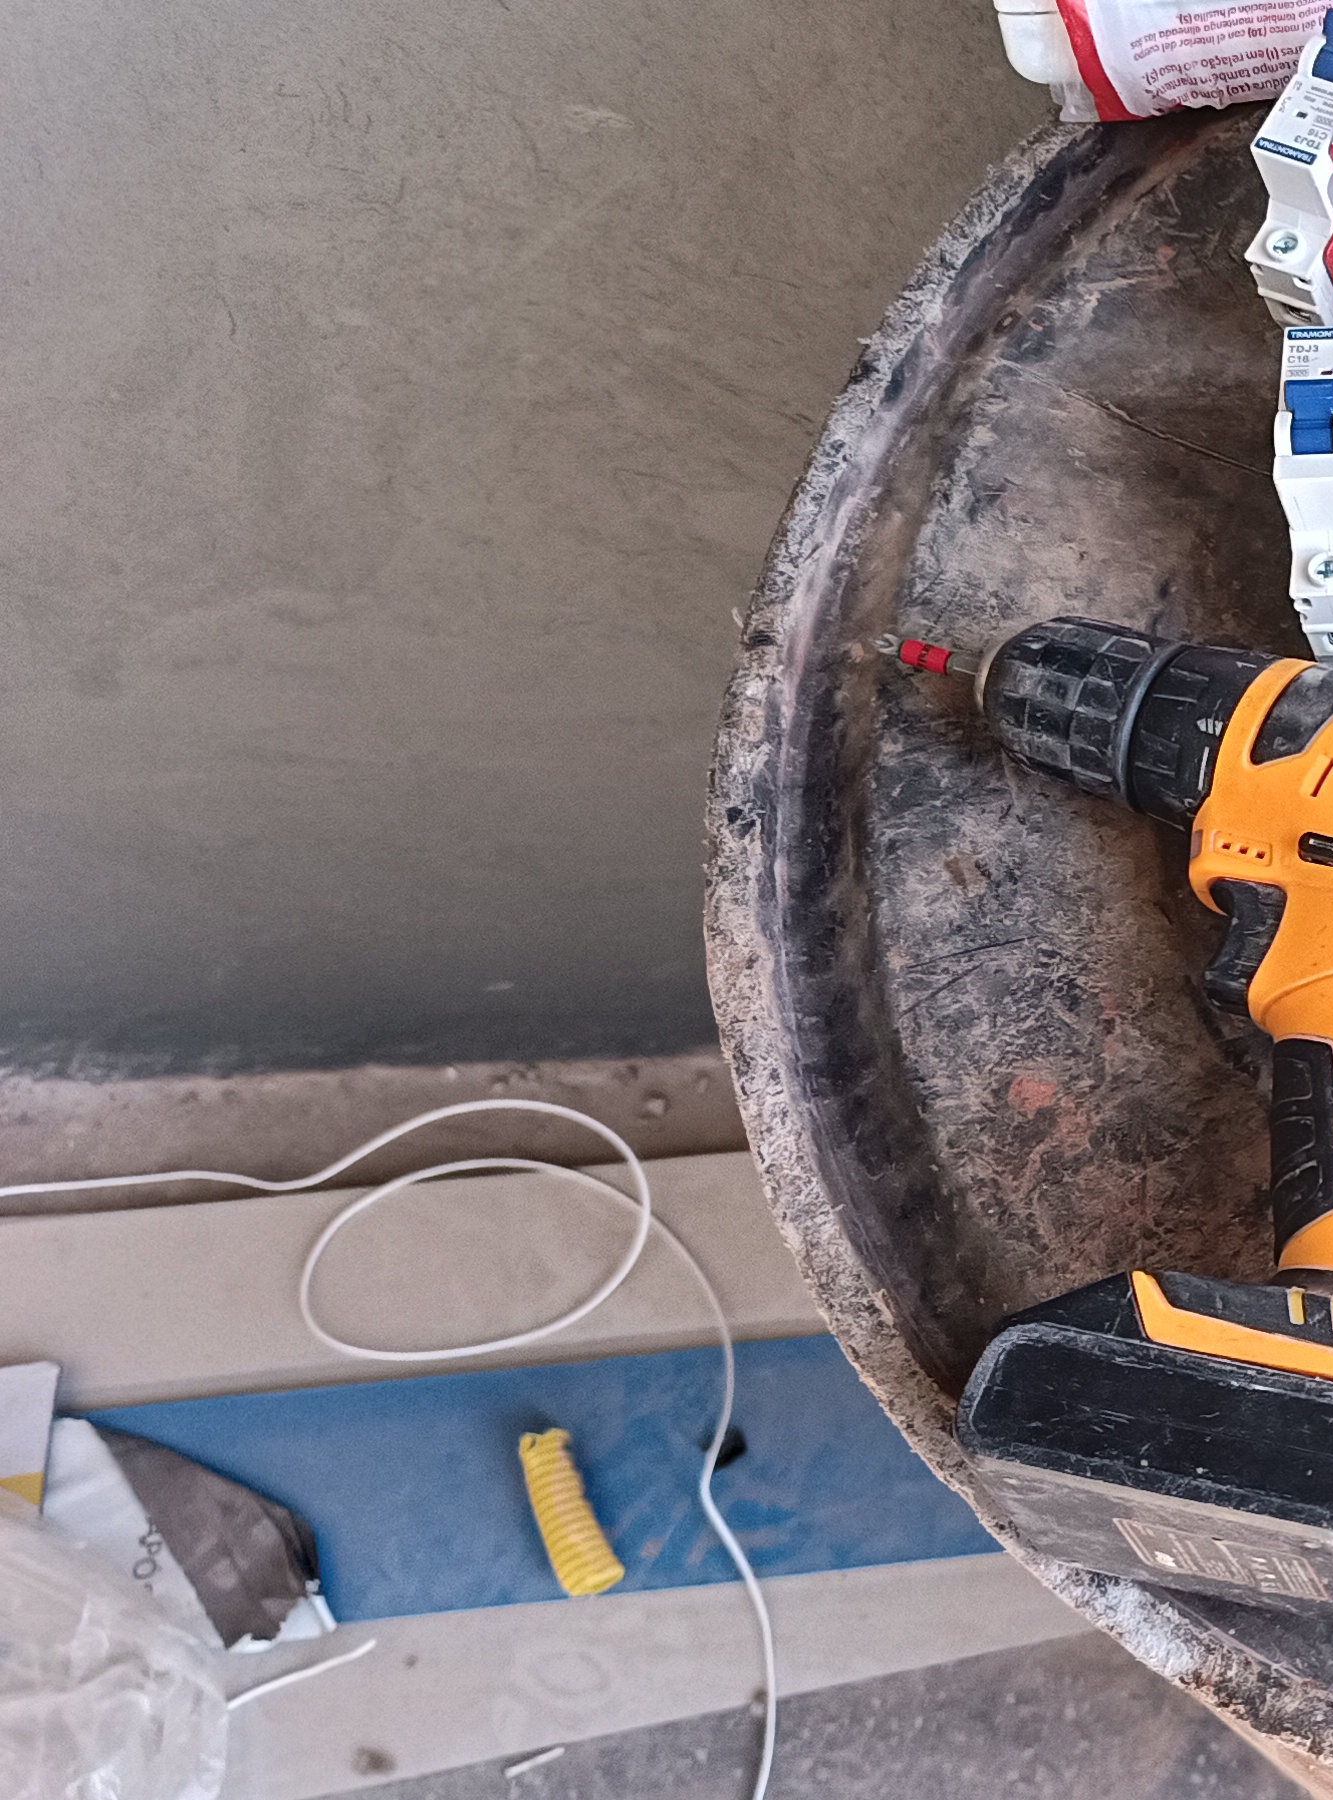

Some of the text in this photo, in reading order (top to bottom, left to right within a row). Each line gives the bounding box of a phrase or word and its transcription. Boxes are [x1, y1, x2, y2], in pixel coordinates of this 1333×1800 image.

[1302, 18, 1317, 29] del
[1228, 30, 1245, 39] con
[1247, 26, 1267, 38] (10)
[1180, 35, 1216, 49] interior
[1246, 49, 1264, 60] em
[1200, 53, 1244, 70] relação
[1251, 60, 1290, 76] tempo
[1226, 82, 1251, 97] (10)
[1258, 139, 1315, 163] TRAMONTINA
[1288, 344, 1320, 354] TDJ3
